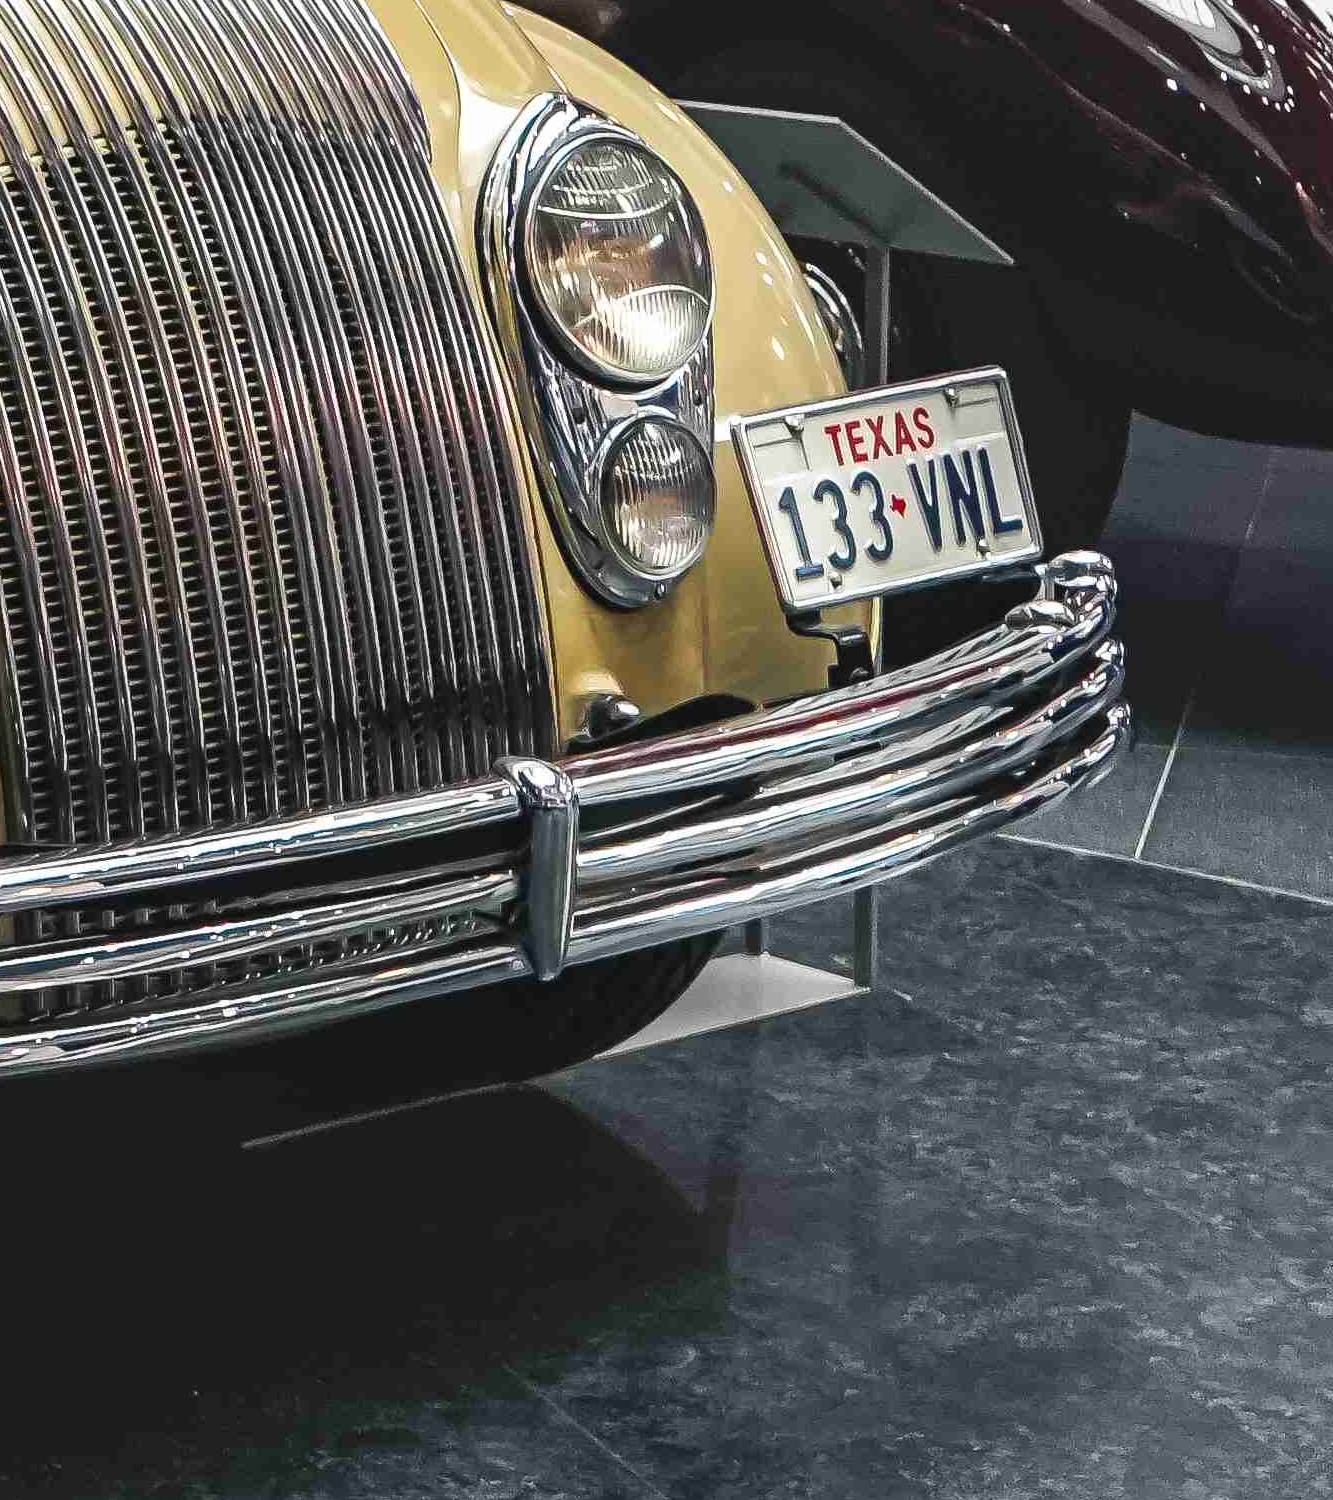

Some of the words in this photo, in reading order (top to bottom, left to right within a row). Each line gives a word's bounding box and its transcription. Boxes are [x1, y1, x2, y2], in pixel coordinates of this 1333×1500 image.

[824, 407, 935, 466] TEXAS
[779, 471, 894, 580] 133
[906, 447, 1024, 553] VNL
